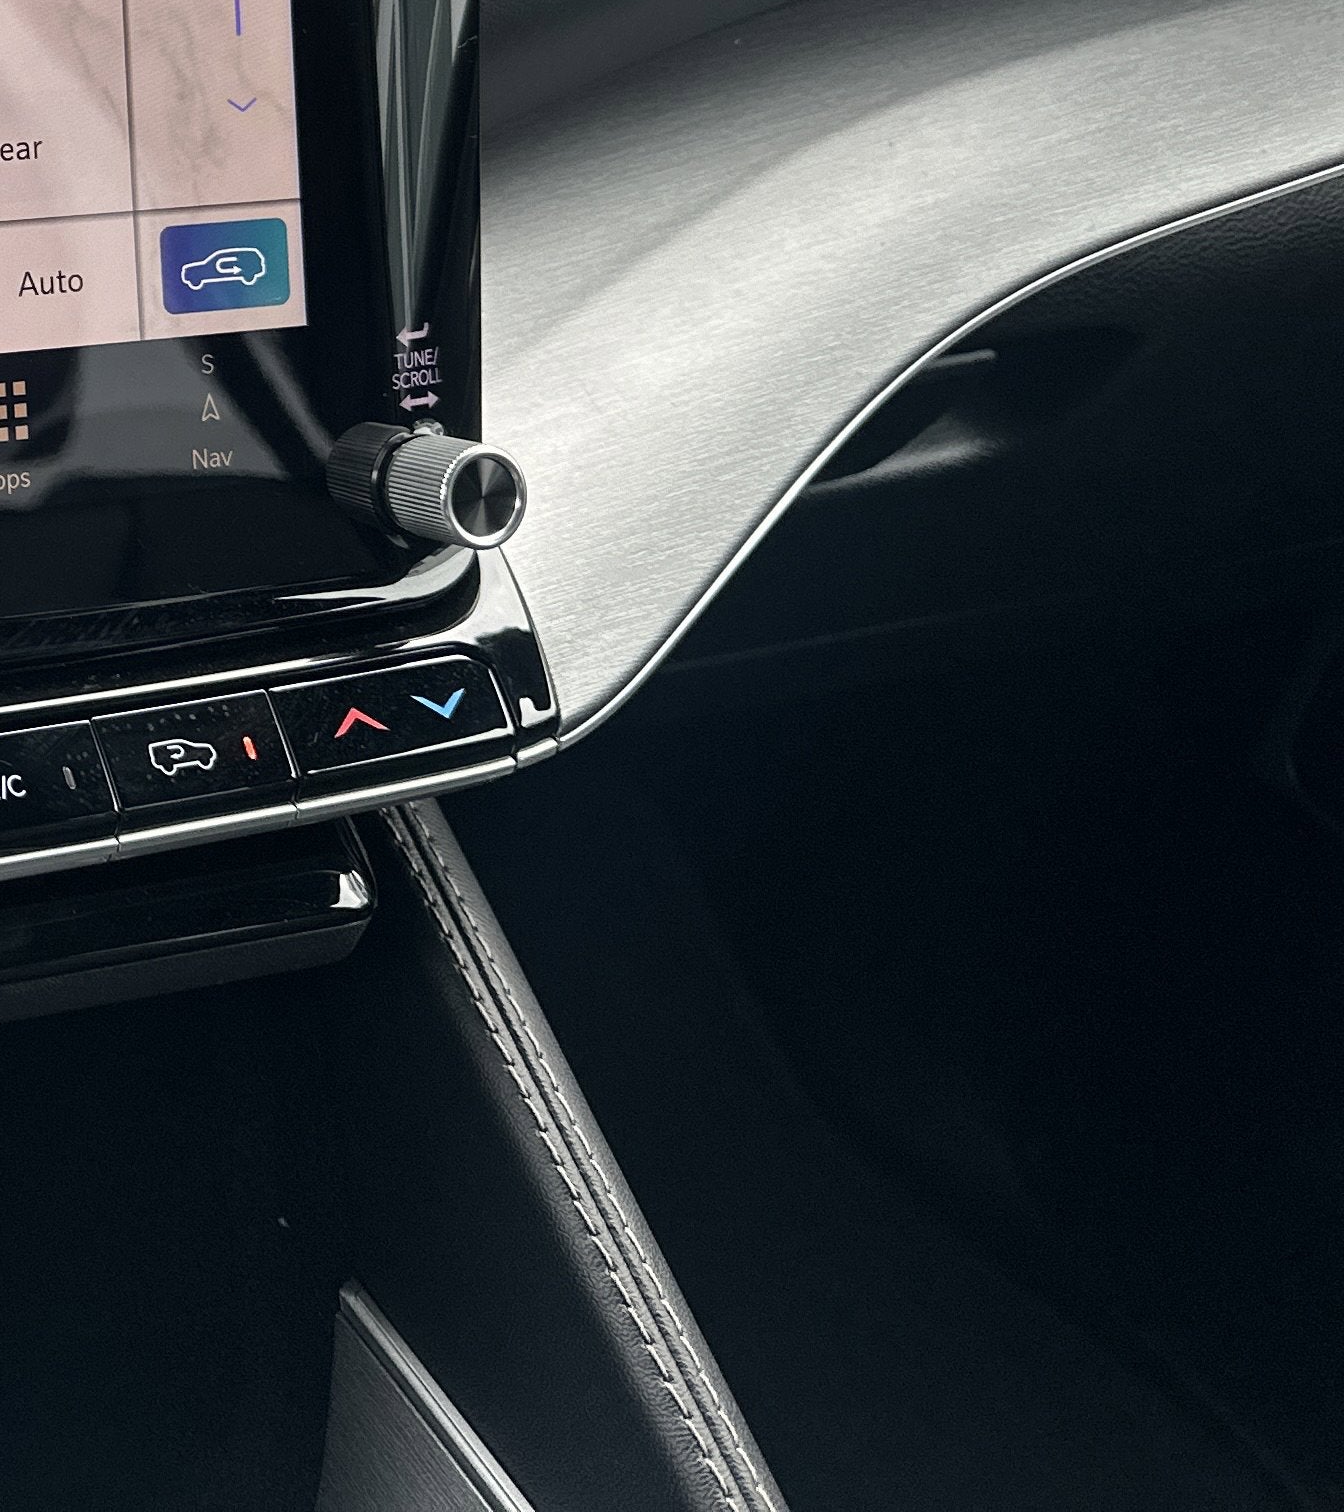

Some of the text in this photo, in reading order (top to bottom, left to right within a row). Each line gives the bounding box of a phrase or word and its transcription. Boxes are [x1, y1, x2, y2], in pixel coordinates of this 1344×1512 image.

[19, 270, 83, 296] Auto
[200, 354, 215, 375] S
[392, 368, 442, 390] SCROLL
[193, 449, 232, 469] Nav
